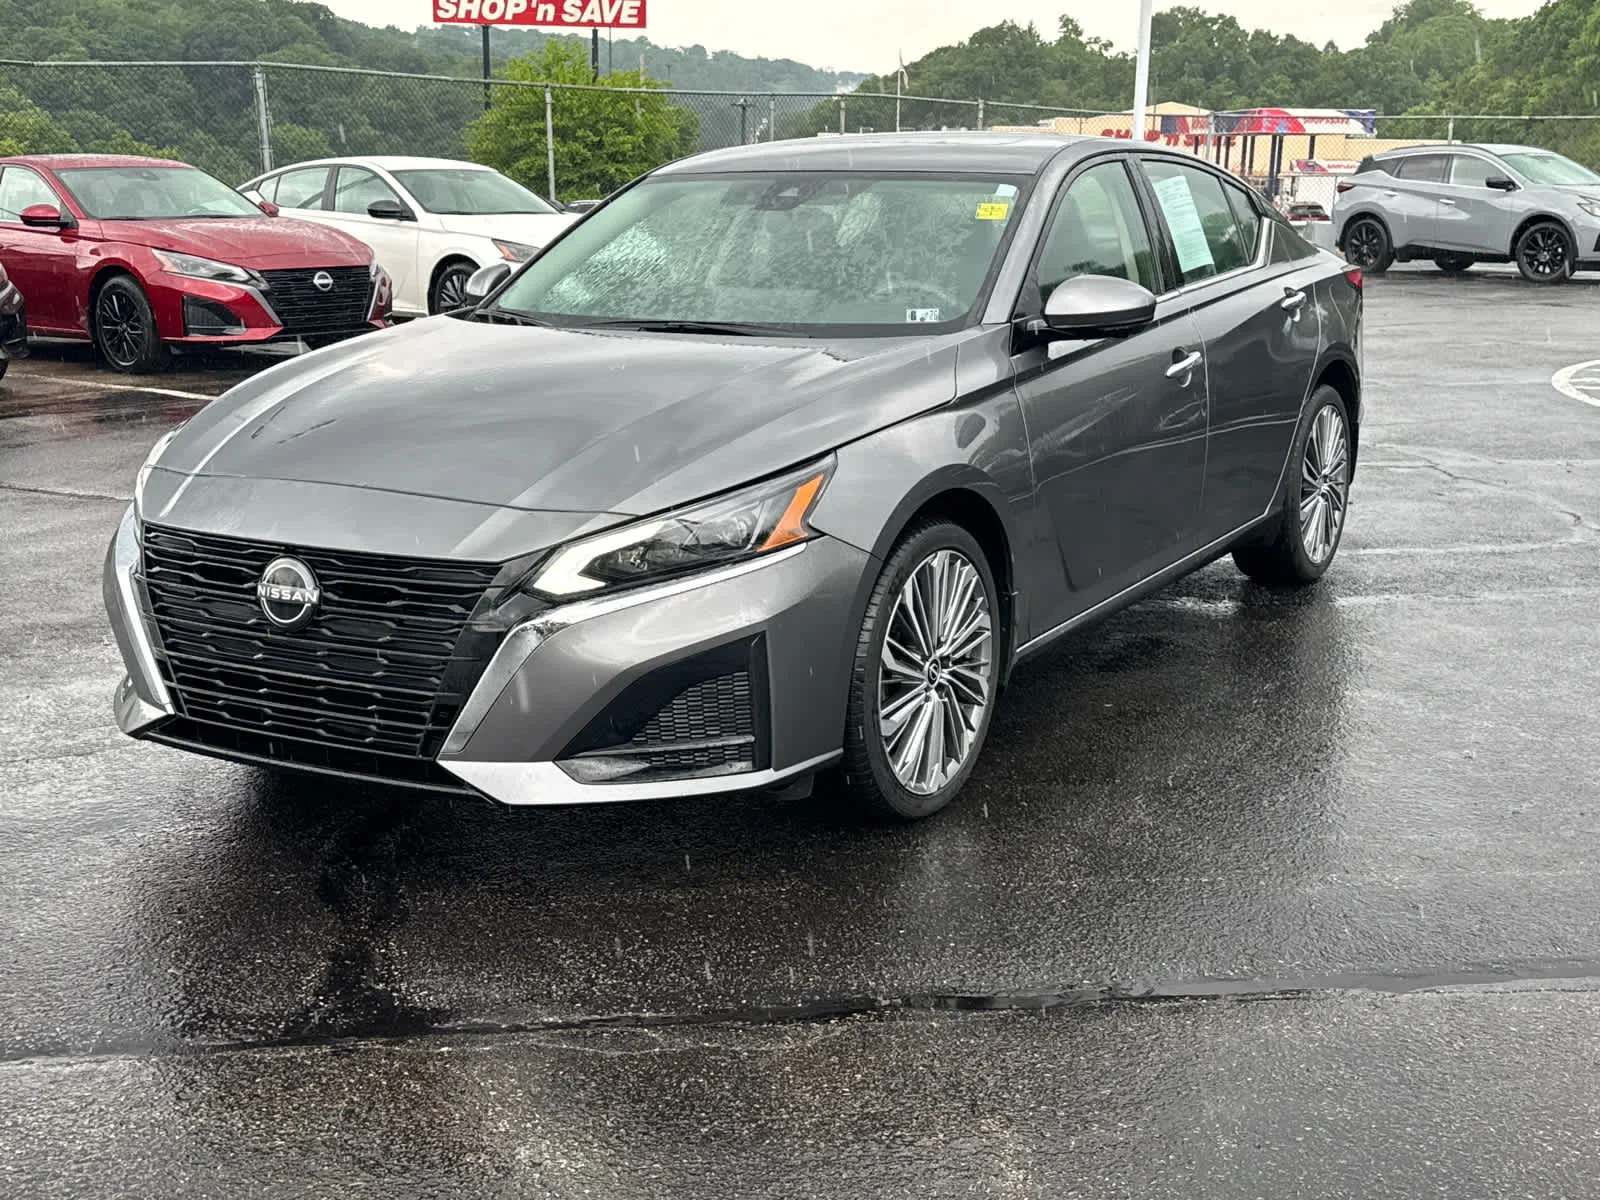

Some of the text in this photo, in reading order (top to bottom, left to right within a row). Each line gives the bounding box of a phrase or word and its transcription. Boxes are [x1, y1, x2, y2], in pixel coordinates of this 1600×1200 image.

[436, 0, 527, 20] SHOP
[561, 0, 641, 24] SAVE
[257, 584, 319, 603] NISSAN
